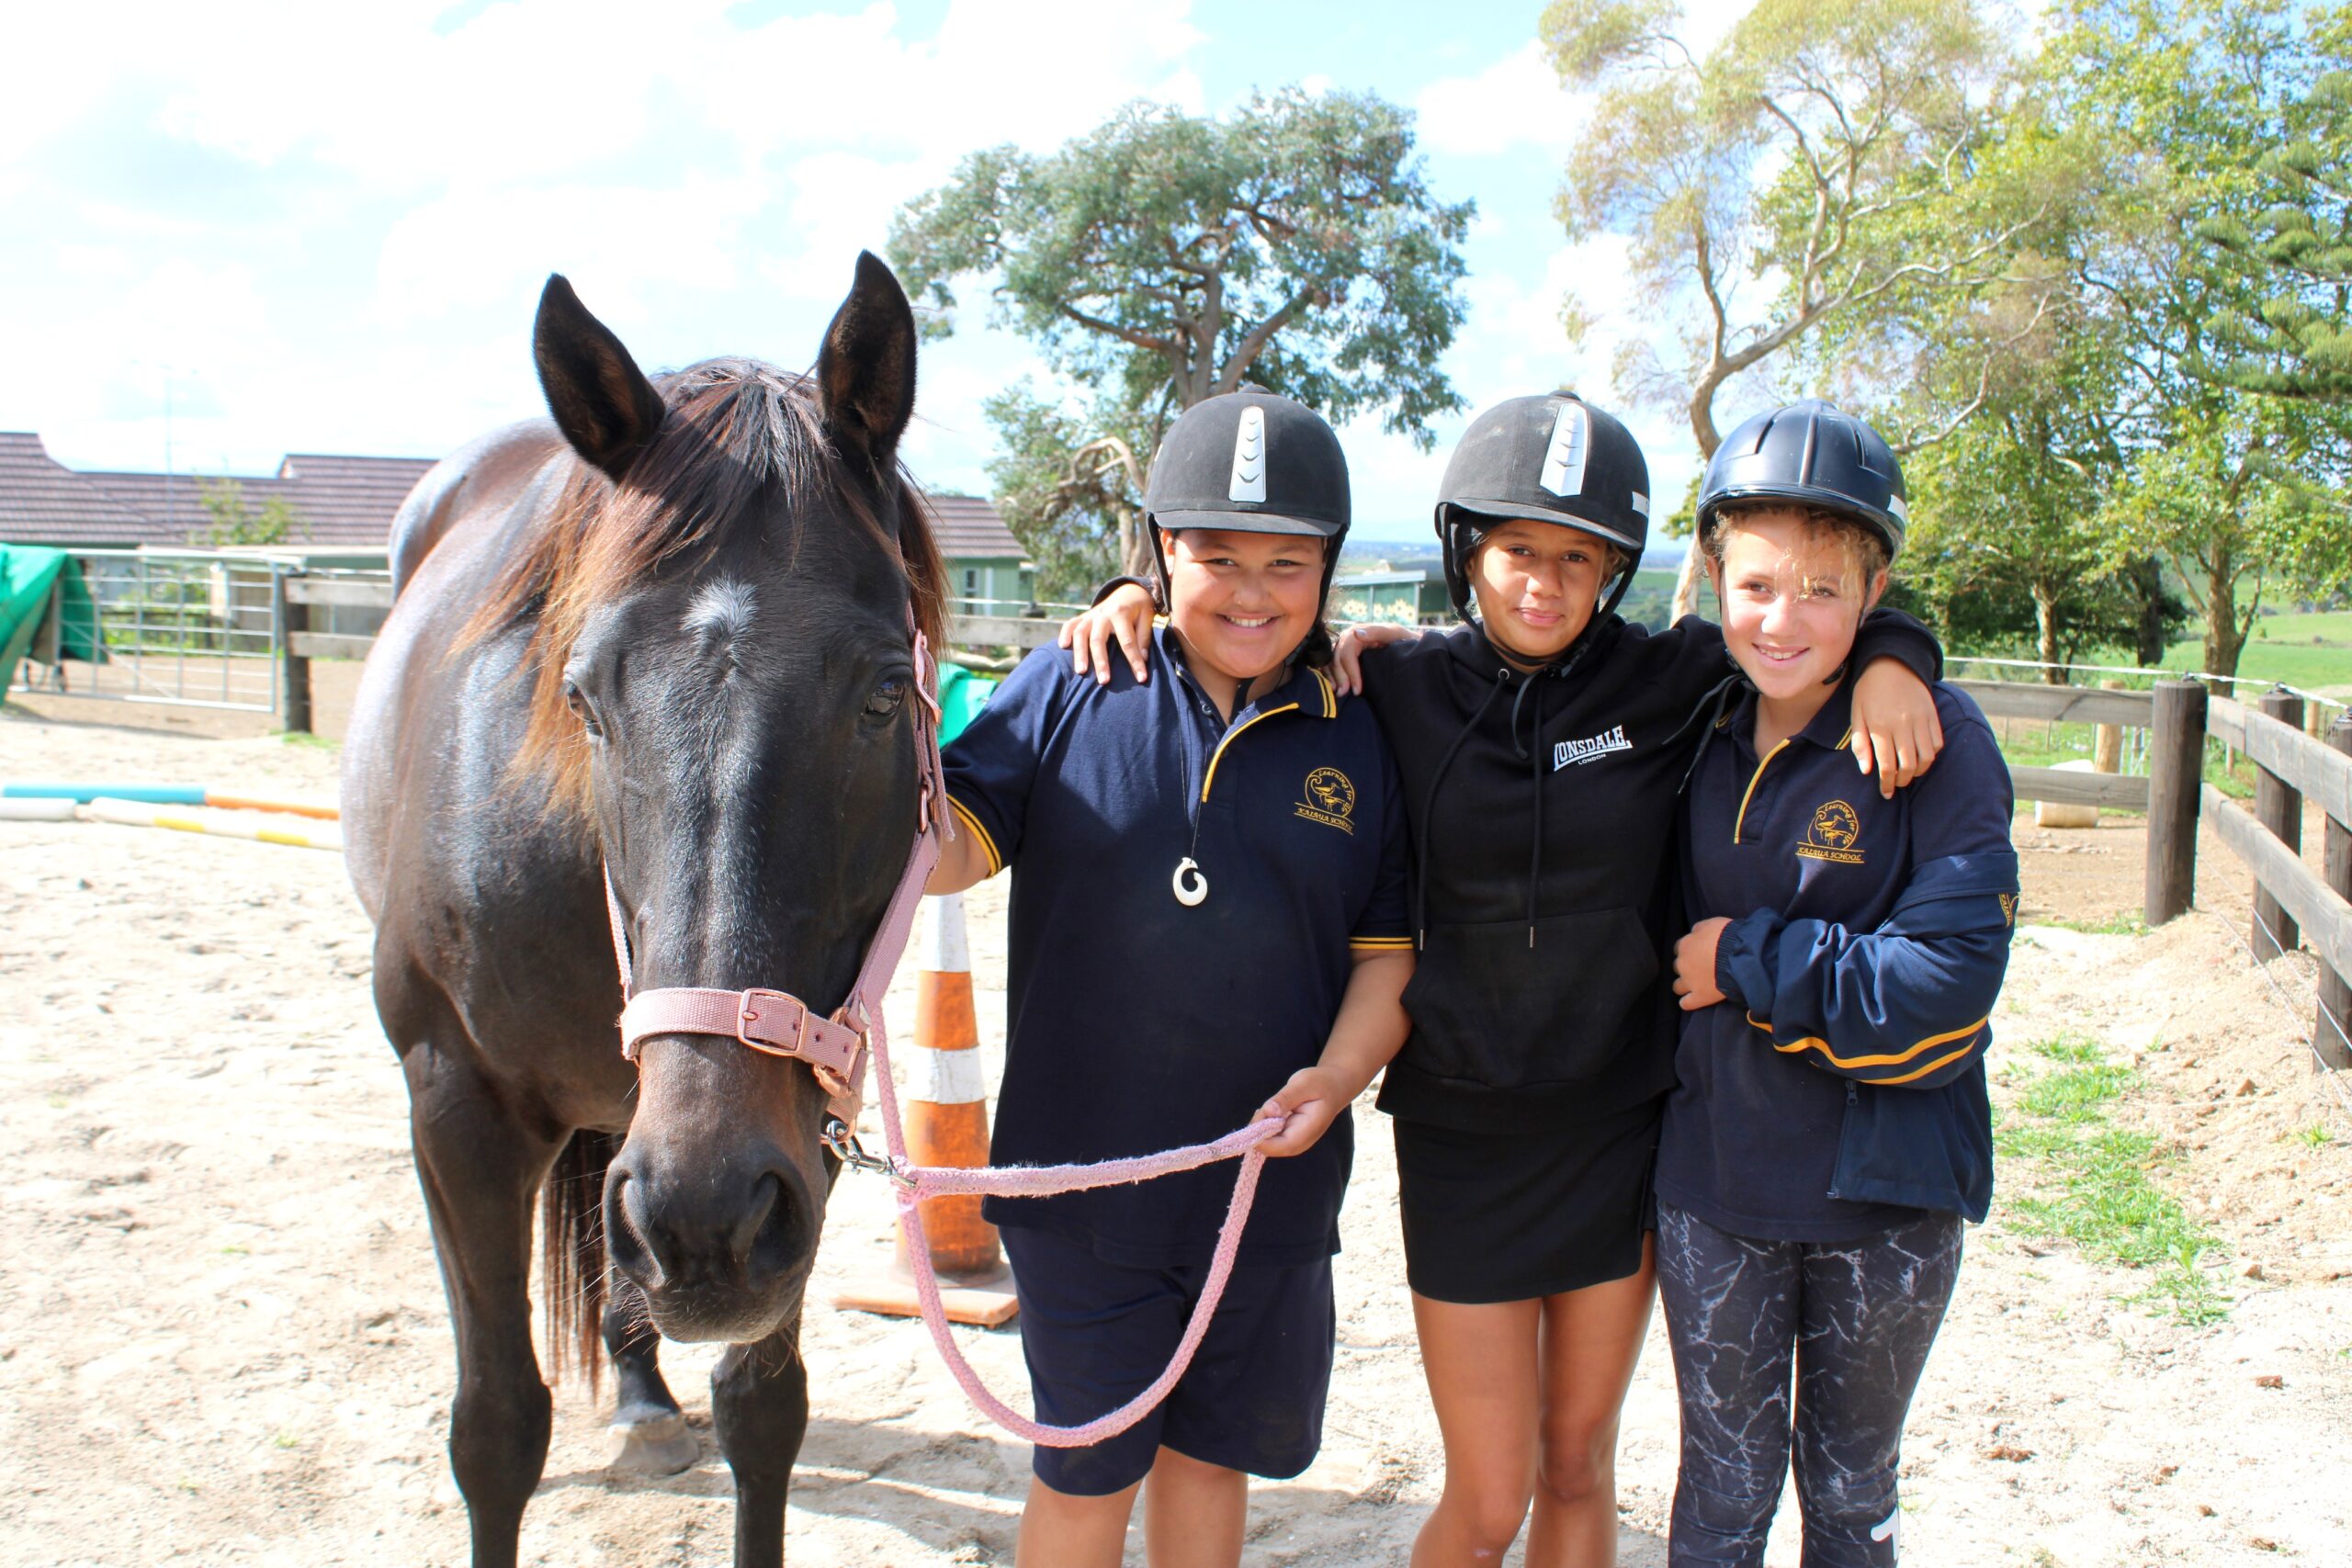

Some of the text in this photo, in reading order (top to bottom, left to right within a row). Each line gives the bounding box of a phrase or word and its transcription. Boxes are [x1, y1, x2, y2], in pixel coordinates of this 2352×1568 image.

[1577, 753, 1607, 765] LONDON
[1318, 770, 1349, 789] Learning
[1343, 789, 1352, 802] for
[1825, 804, 1853, 819] Learning
[1846, 819, 1856, 832] for
[1830, 852, 1862, 862] SCHOOL
